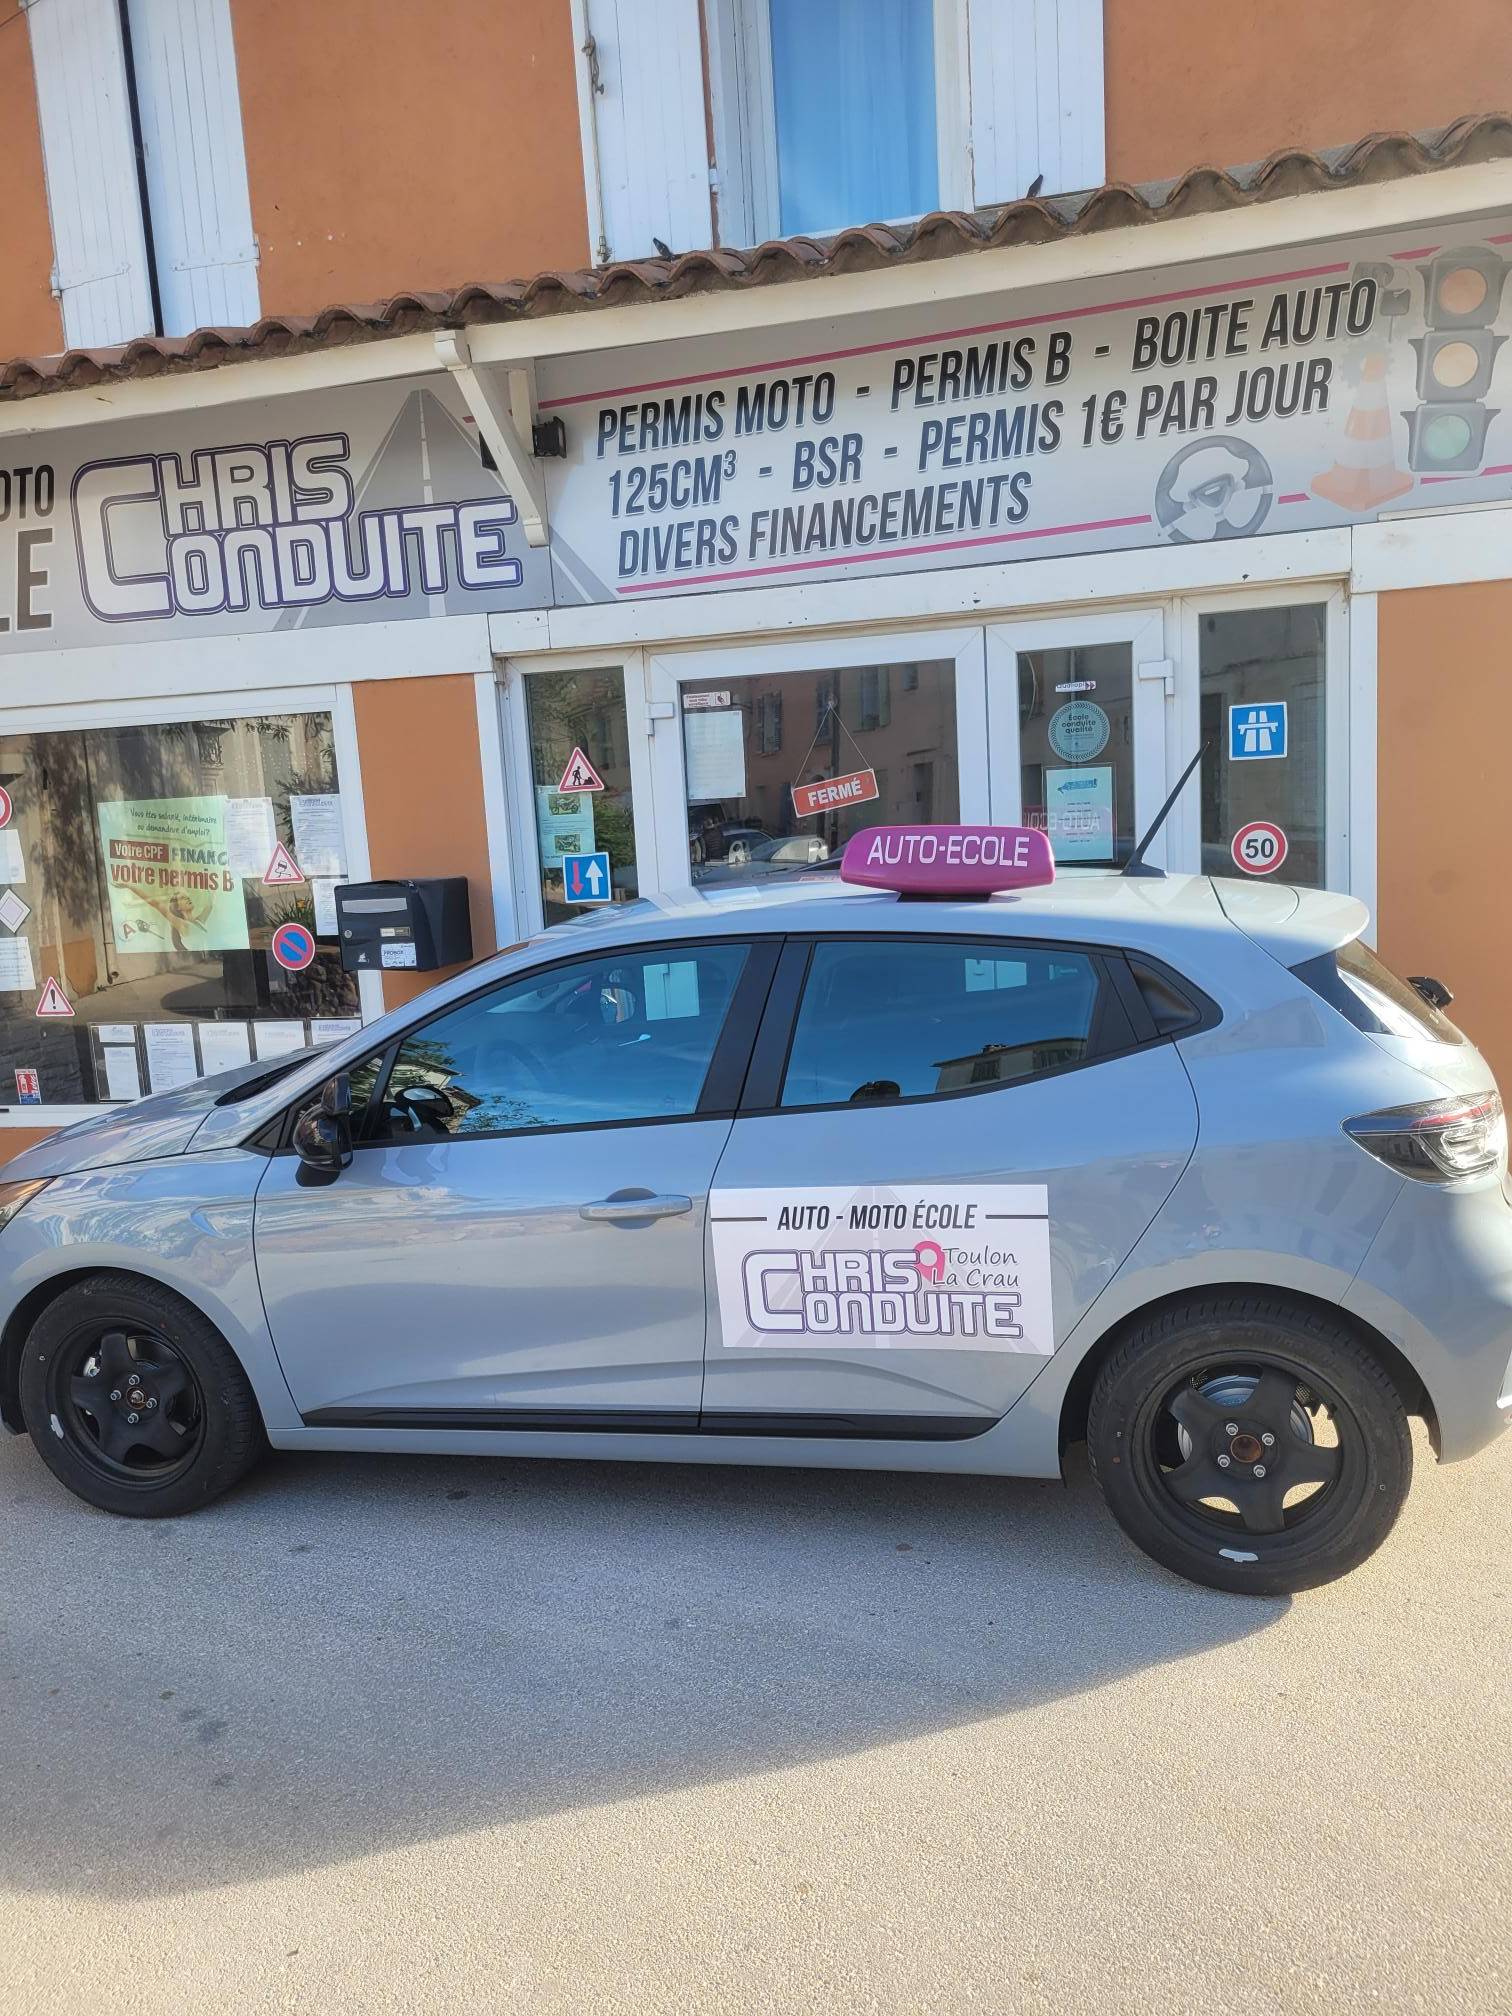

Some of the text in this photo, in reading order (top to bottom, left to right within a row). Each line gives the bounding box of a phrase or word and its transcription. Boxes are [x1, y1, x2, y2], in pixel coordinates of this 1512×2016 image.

[597, 390, 725, 459] PERMIS
[734, 370, 836, 437] MOTO
[890, 337, 1034, 411] PERMIS
[1044, 332, 1072, 385] B
[1131, 300, 1255, 372] BOITE
[1260, 277, 1378, 351] AUTO
[792, 432, 864, 491] BSR
[917, 400, 1065, 472] PERMIS
[1081, 389, 1127, 447] 1€
[1136, 375, 1218, 439] PAR
[1225, 357, 1333, 426] JOUR
[70, 431, 354, 623] CHRIS
[617, 472, 1032, 578] DIVERS FINANCEMENTS
[0, 527, 53, 632] E
[1061, 720, 1096, 728] conduite
[1065, 726, 1093, 734] qualité
[807, 777, 863, 807] FERMÉ
[115, 843, 142, 858] Votre
[144, 844, 163, 859] CPF
[867, 835, 1030, 867] AUTO-ECOLE
[1245, 838, 1275, 859] 50
[111, 863, 235, 892] votre permis B
[777, 1205, 830, 1231] AUTO
[849, 1204, 906, 1230] MOTO
[912, 1200, 978, 1230] ÉCOLE
[944, 1245, 1018, 1266] Toulon
[742, 1249, 922, 1335] CHRIS
[932, 1268, 1019, 1288] La Crau
